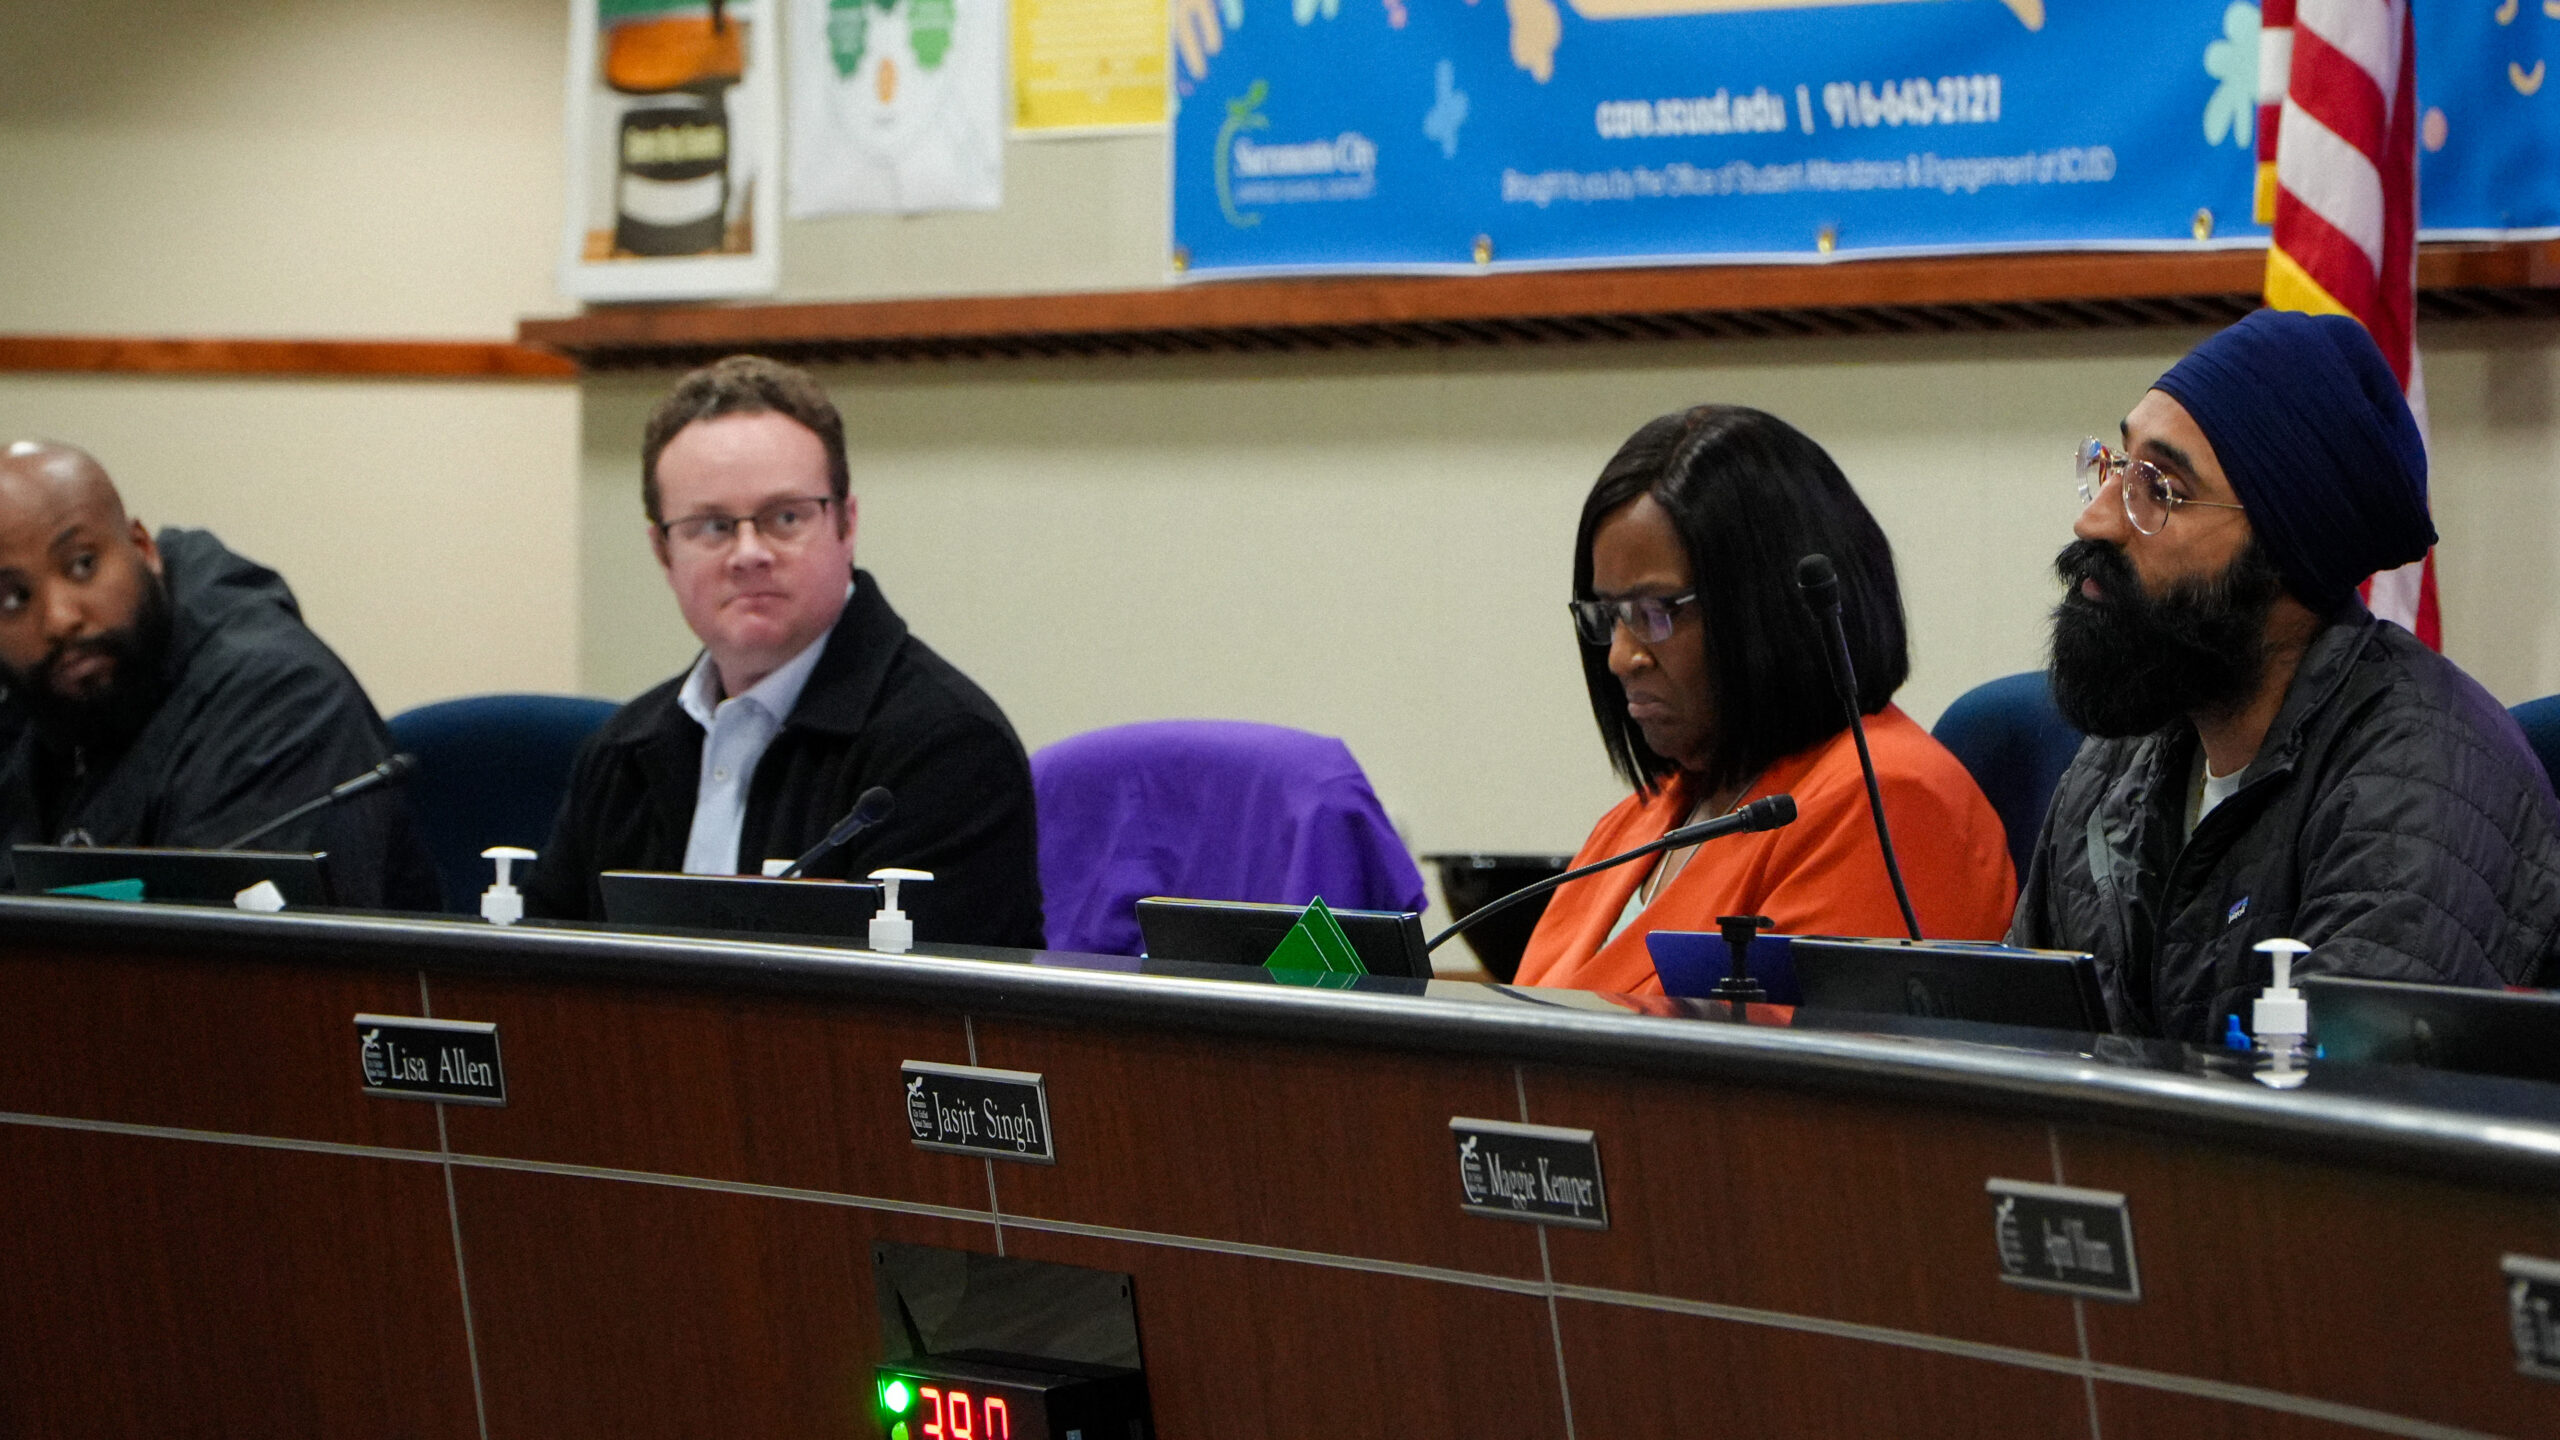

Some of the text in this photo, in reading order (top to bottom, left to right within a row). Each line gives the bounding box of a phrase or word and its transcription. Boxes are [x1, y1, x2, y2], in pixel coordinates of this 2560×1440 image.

[1823, 73, 2001, 128] 916-643-2121
[386, 1042, 429, 1082] Lisa
[438, 1047, 494, 1087] Allen
[932, 1091, 1039, 1152] Jasjit Singh
[1485, 1151, 1537, 1210] Maggie
[1537, 1156, 1594, 1217] Kemper
